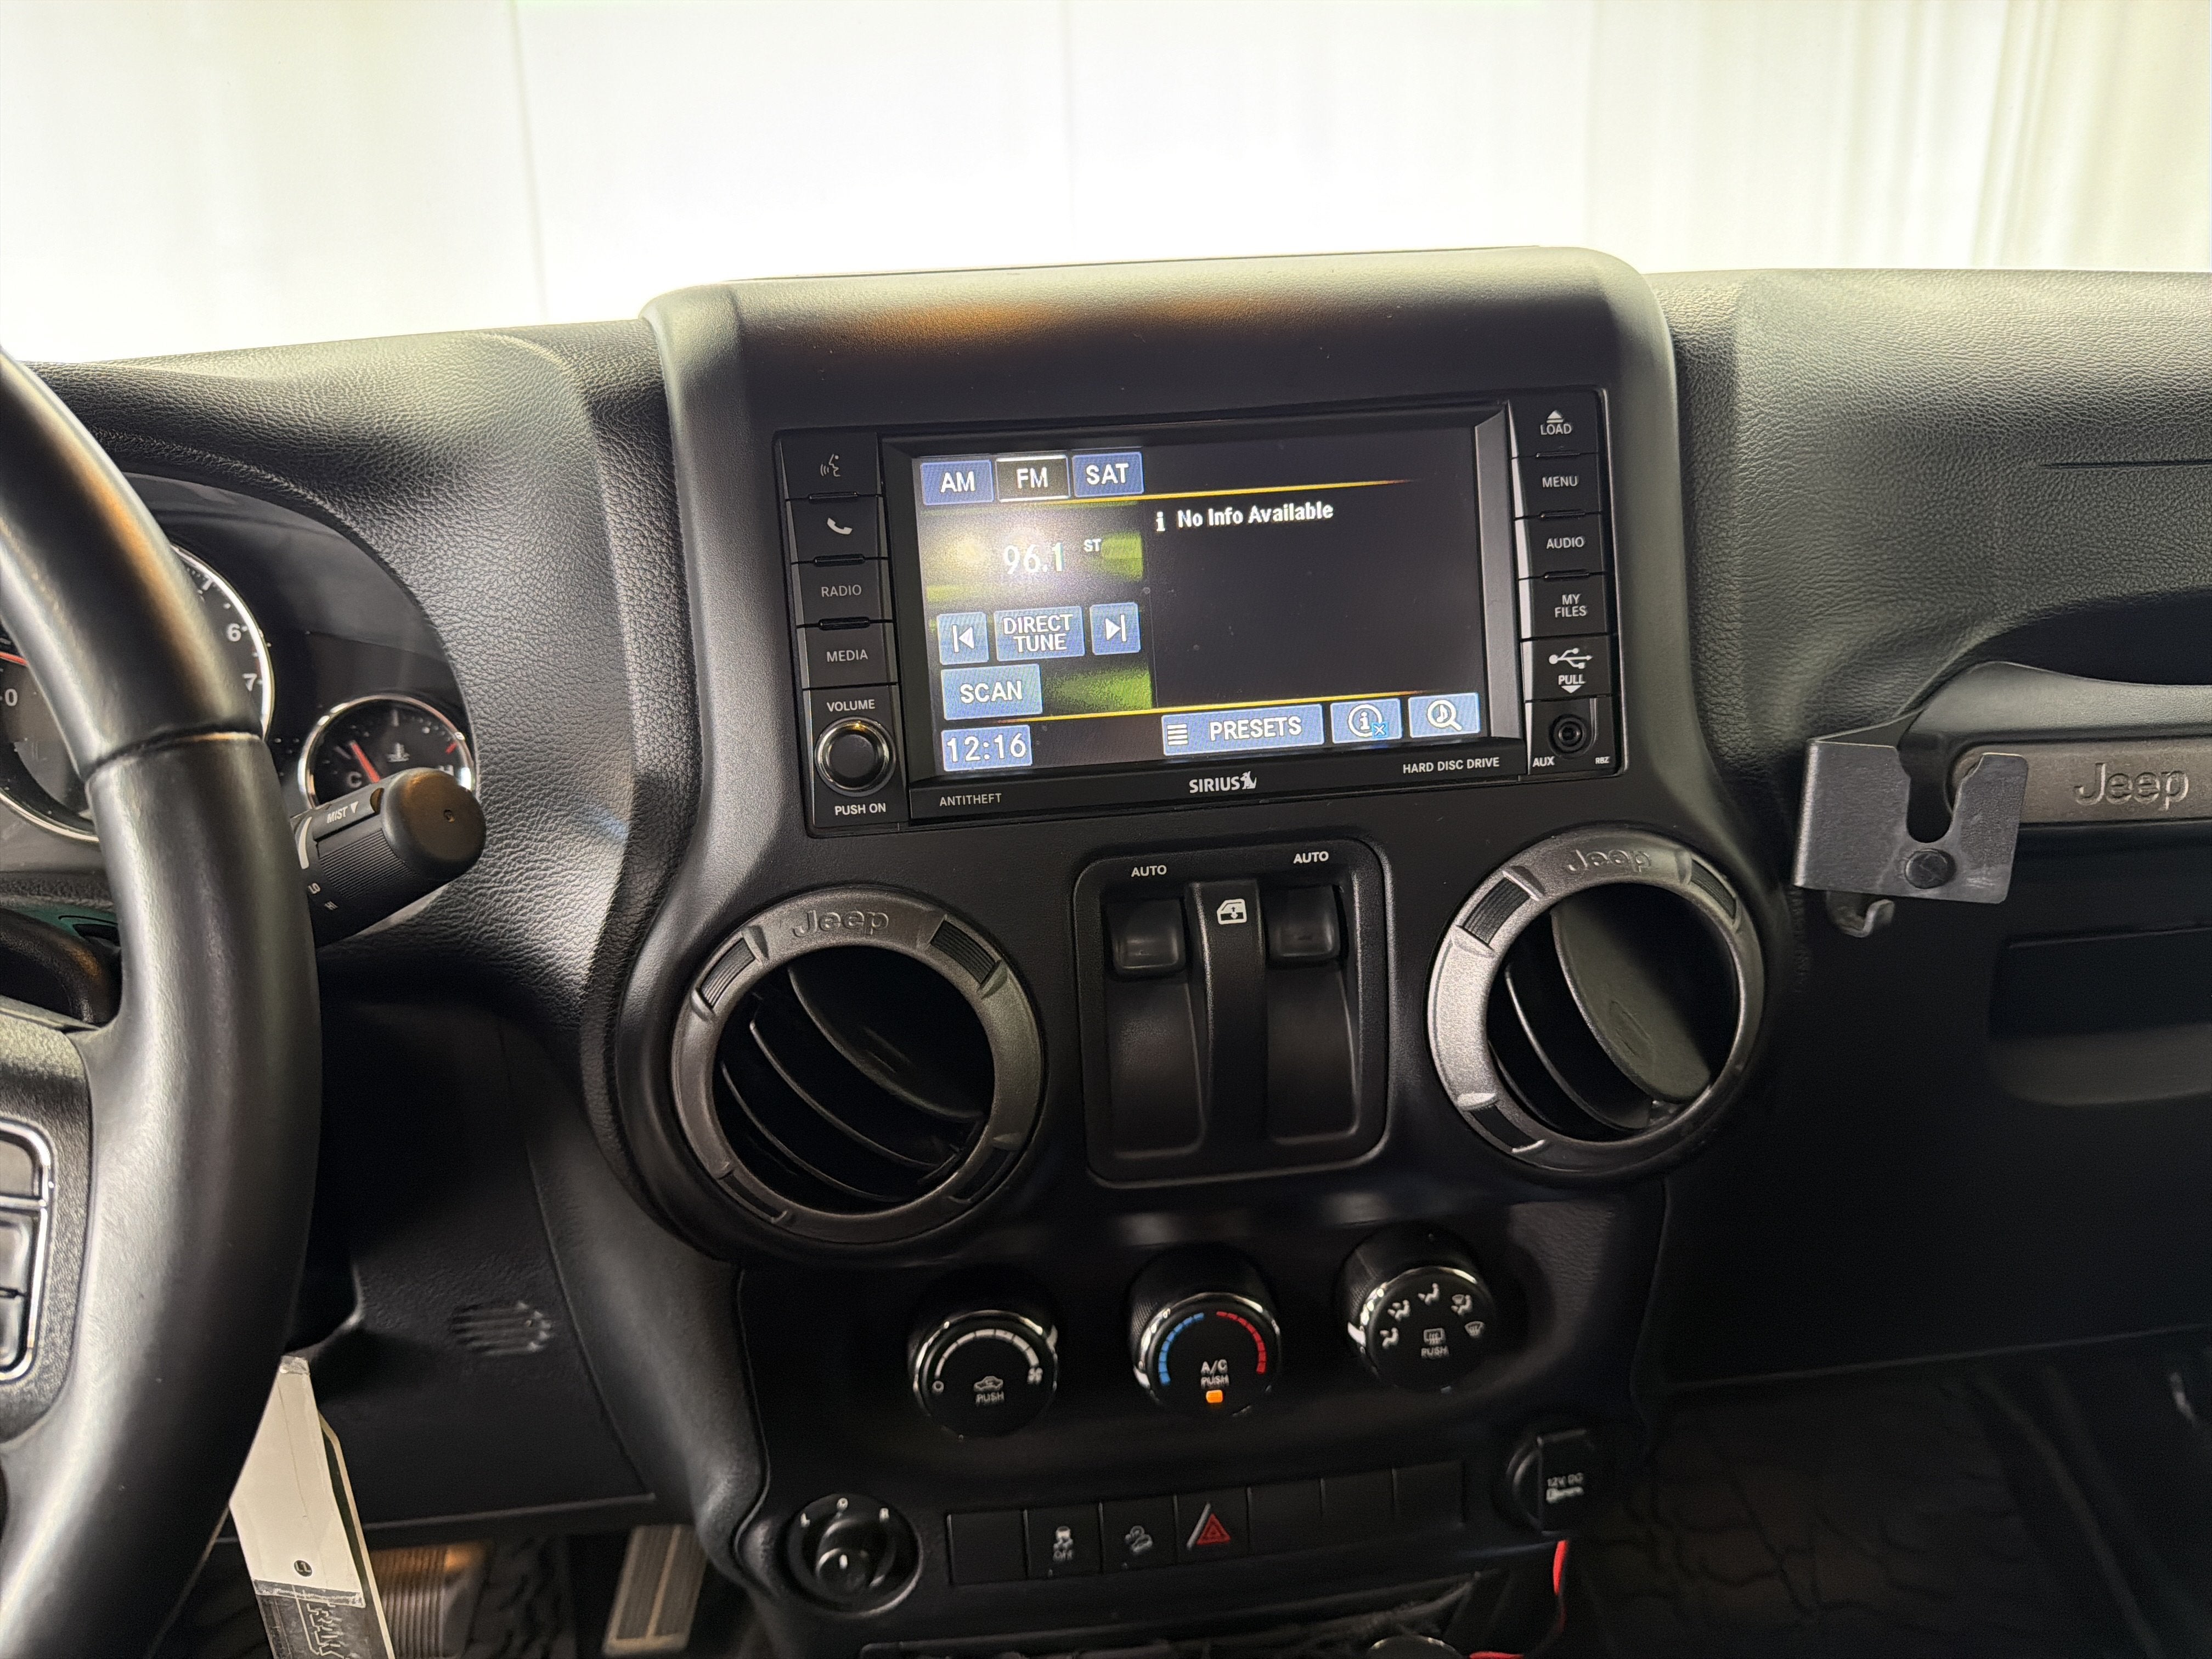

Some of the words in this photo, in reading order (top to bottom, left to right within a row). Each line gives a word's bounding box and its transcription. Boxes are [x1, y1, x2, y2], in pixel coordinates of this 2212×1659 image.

[1540, 424, 1572, 435] LOAD
[1015, 466, 1048, 489] FM
[1086, 463, 1129, 485] SAT
[940, 470, 976, 494] AM
[1542, 475, 1578, 488] MENU
[1177, 509, 1203, 528] No
[1208, 506, 1244, 526] Info
[1248, 500, 1334, 524] Available
[1084, 538, 1102, 552] ST
[1546, 537, 1584, 549] AUDIO
[1003, 541, 1064, 575] 96.1
[821, 584, 862, 597] RADIO
[1561, 593, 1582, 605] MY
[1554, 605, 1588, 618] FILES
[1003, 614, 1073, 634] DIRECT
[227, 623, 241, 642] 6
[1013, 633, 1067, 652] TUNE
[826, 648, 868, 662] MEDIA
[242, 673, 257, 692] 7
[1558, 674, 1586, 685] PULL
[960, 680, 1023, 704] SCAN
[826, 698, 876, 712] VOLUME
[1210, 715, 1302, 742] PRESETS
[946, 733, 1027, 763] 12:16
[1403, 762, 1435, 775] HARD
[1437, 760, 1465, 772] DISC
[1466, 757, 1500, 770] DRIVE
[1532, 756, 1555, 768] AUX
[1189, 775, 1241, 794] SIRIUS
[2074, 761, 2190, 810] Jeep
[939, 793, 1002, 807] ANTITHEFT
[327, 806, 348, 823] MIST
[834, 804, 866, 816] PUSH
[868, 803, 886, 814] ON
[1293, 851, 1329, 864] AUTO
[1566, 849, 1652, 873] Jeep
[1131, 865, 1167, 878] AUTO
[307, 882, 321, 895] LO
[792, 909, 890, 938] Jeep
[1421, 1346, 1449, 1358] PUSH
[1201, 1359, 1228, 1374] A/C
[1201, 1375, 1229, 1388] PUSH
[975, 1391, 1005, 1405] PUSH
